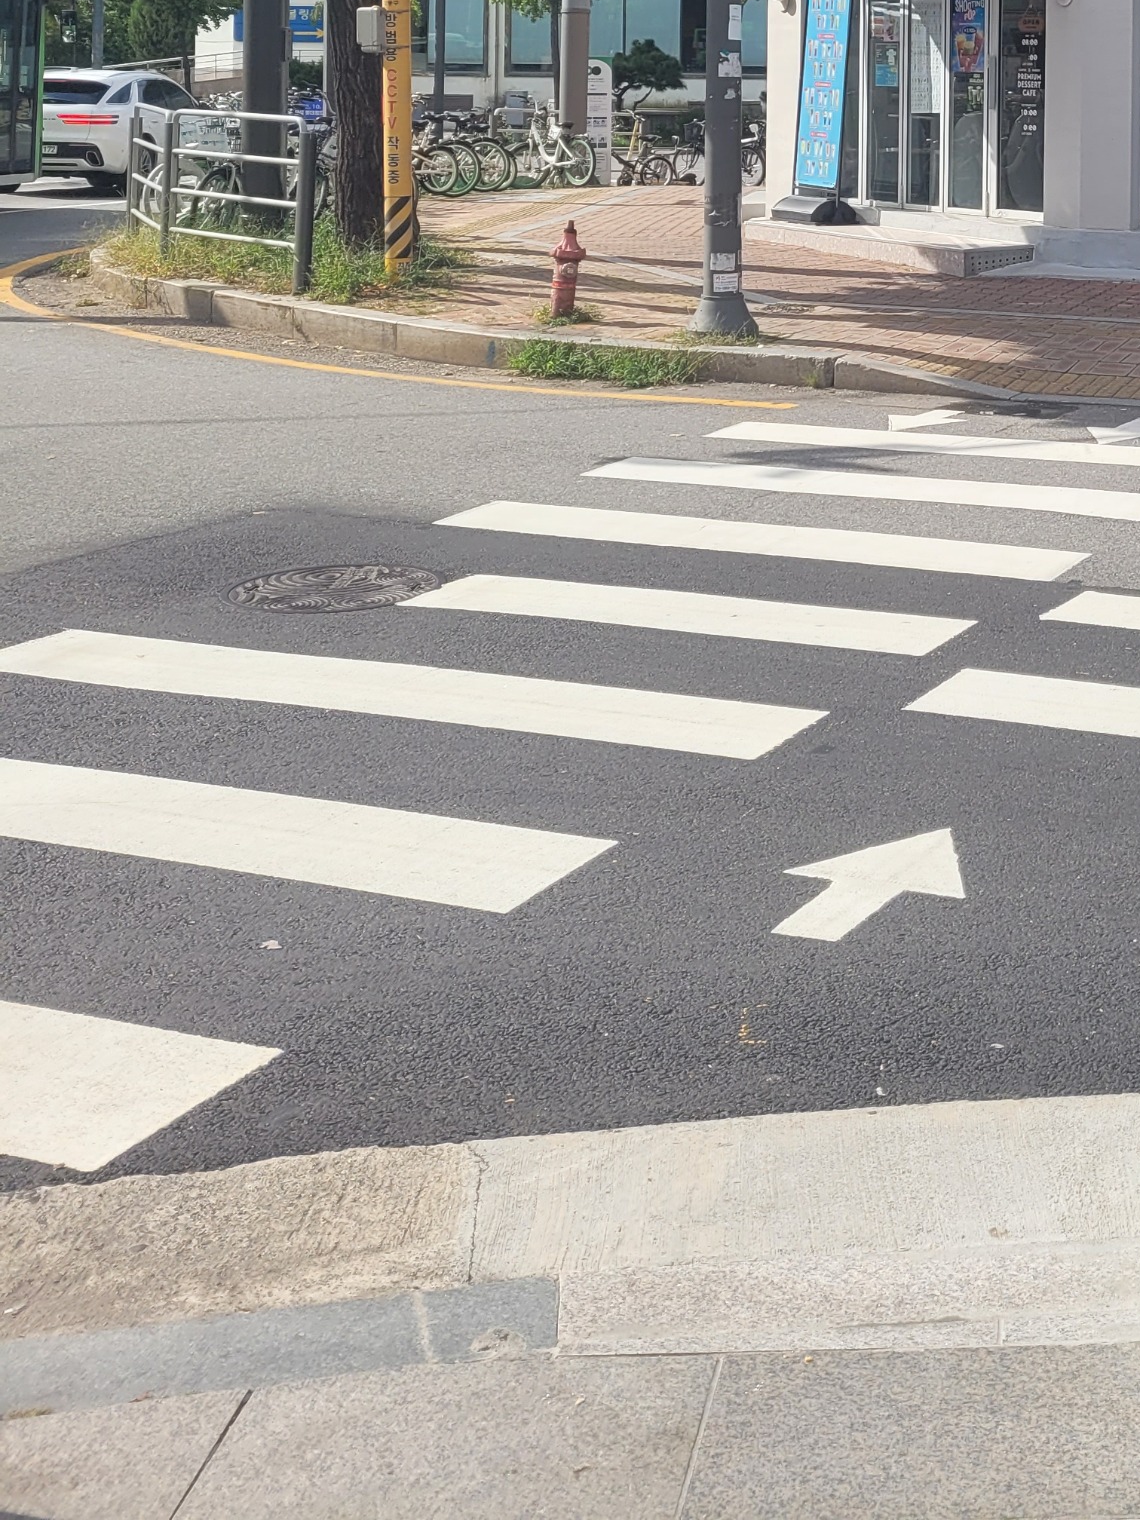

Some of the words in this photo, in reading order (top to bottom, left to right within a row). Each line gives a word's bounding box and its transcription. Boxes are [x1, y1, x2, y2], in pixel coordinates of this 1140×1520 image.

[385, 12, 398, 62] 방범용
[386, 68, 398, 130] CCTV
[1018, 72, 1041, 80] PREMIUM
[1022, 89, 1037, 97] CAFE
[386, 136, 400, 185] 작동중
